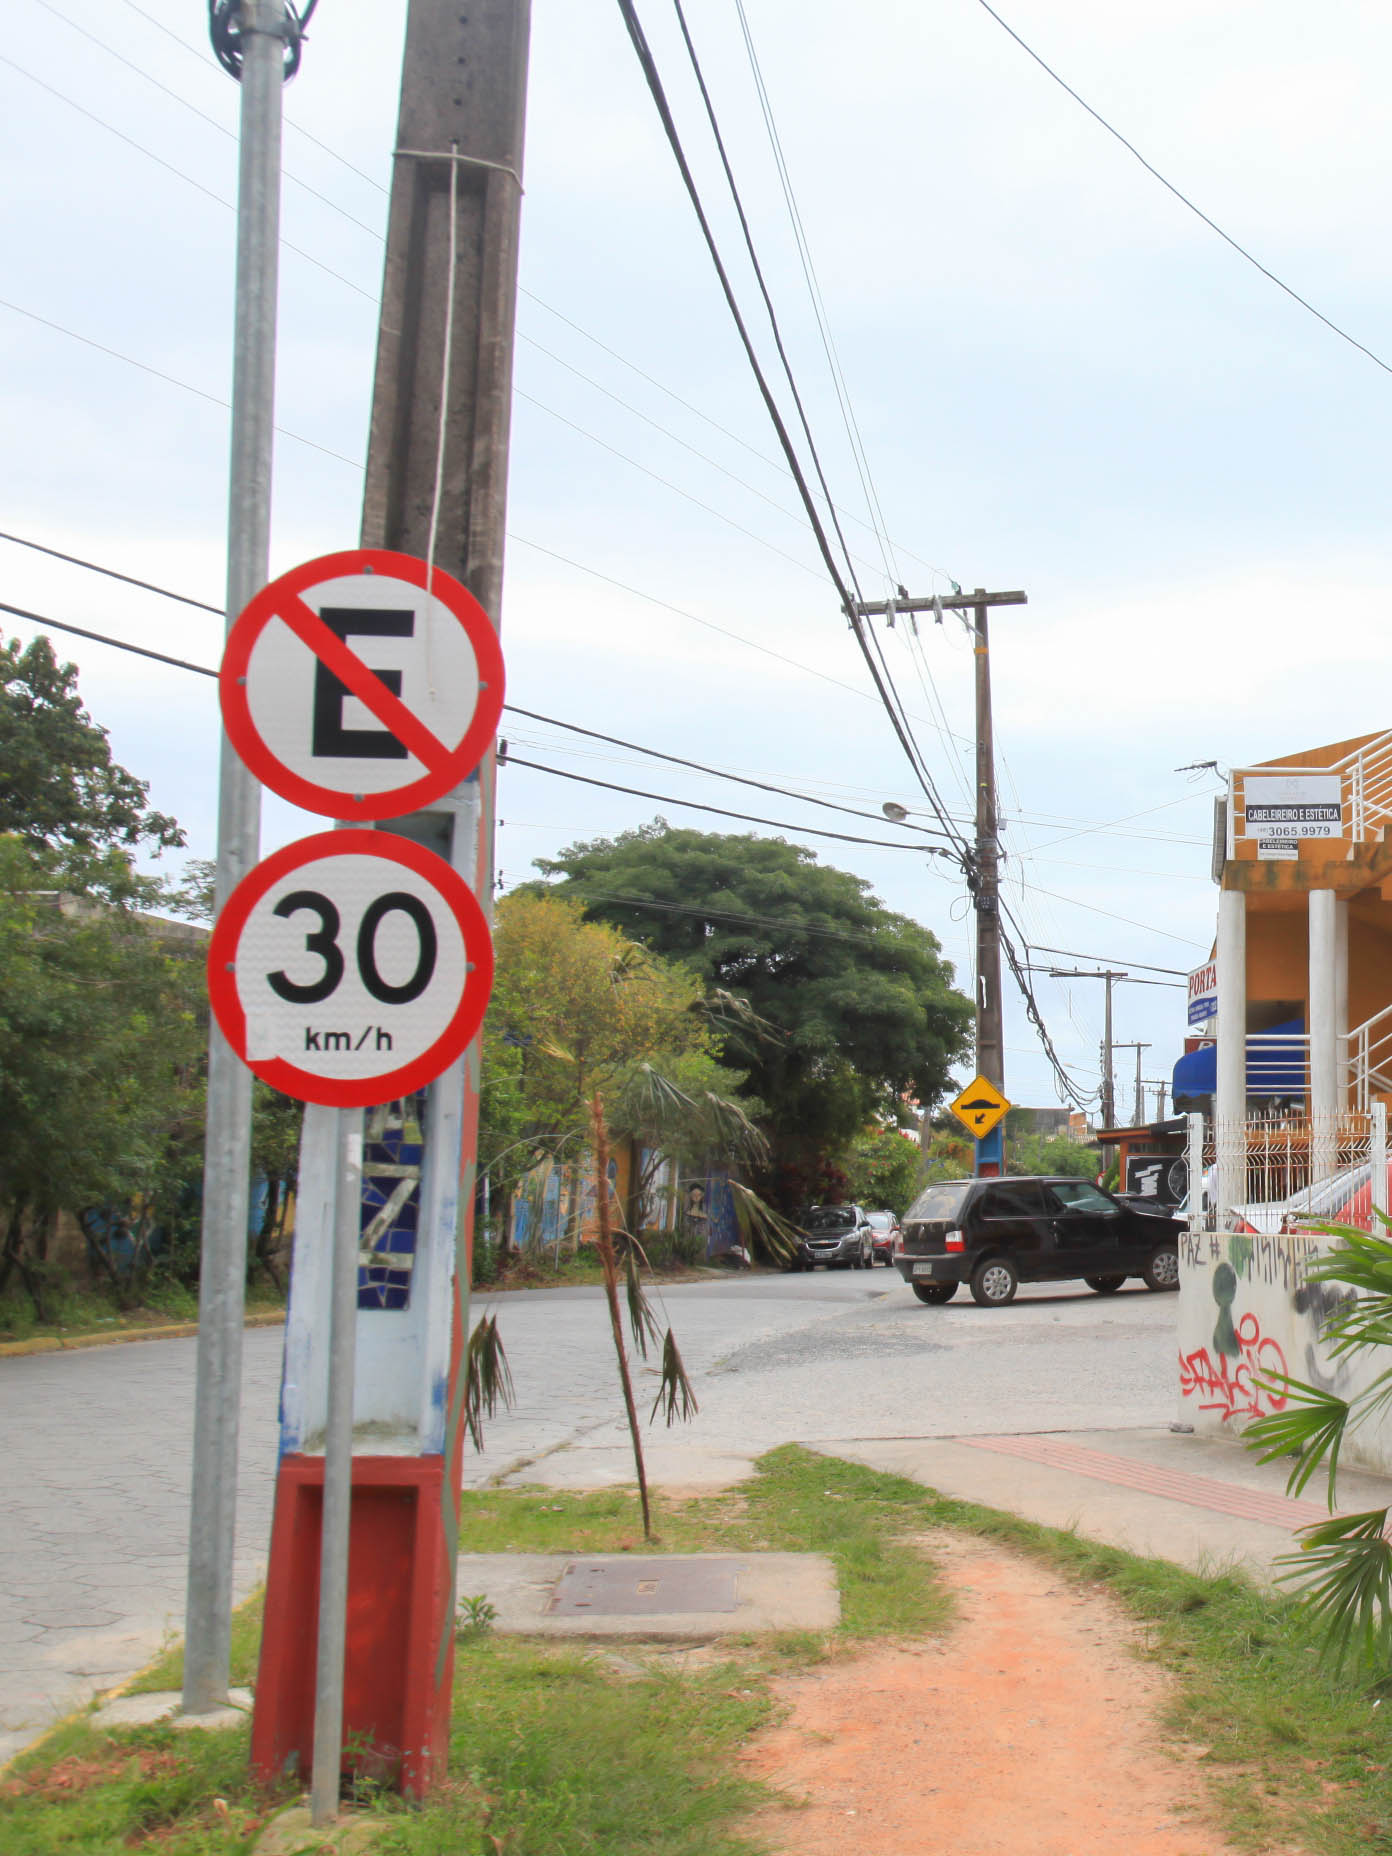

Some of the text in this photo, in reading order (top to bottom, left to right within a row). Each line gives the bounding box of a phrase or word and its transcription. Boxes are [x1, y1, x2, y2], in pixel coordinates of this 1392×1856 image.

[312, 607, 416, 760] E
[1248, 808, 1298, 821] CABELEIREIRO
[1299, 808, 1305, 820] E
[266, 890, 438, 1005] 30
[305, 1026, 393, 1051] km/h
